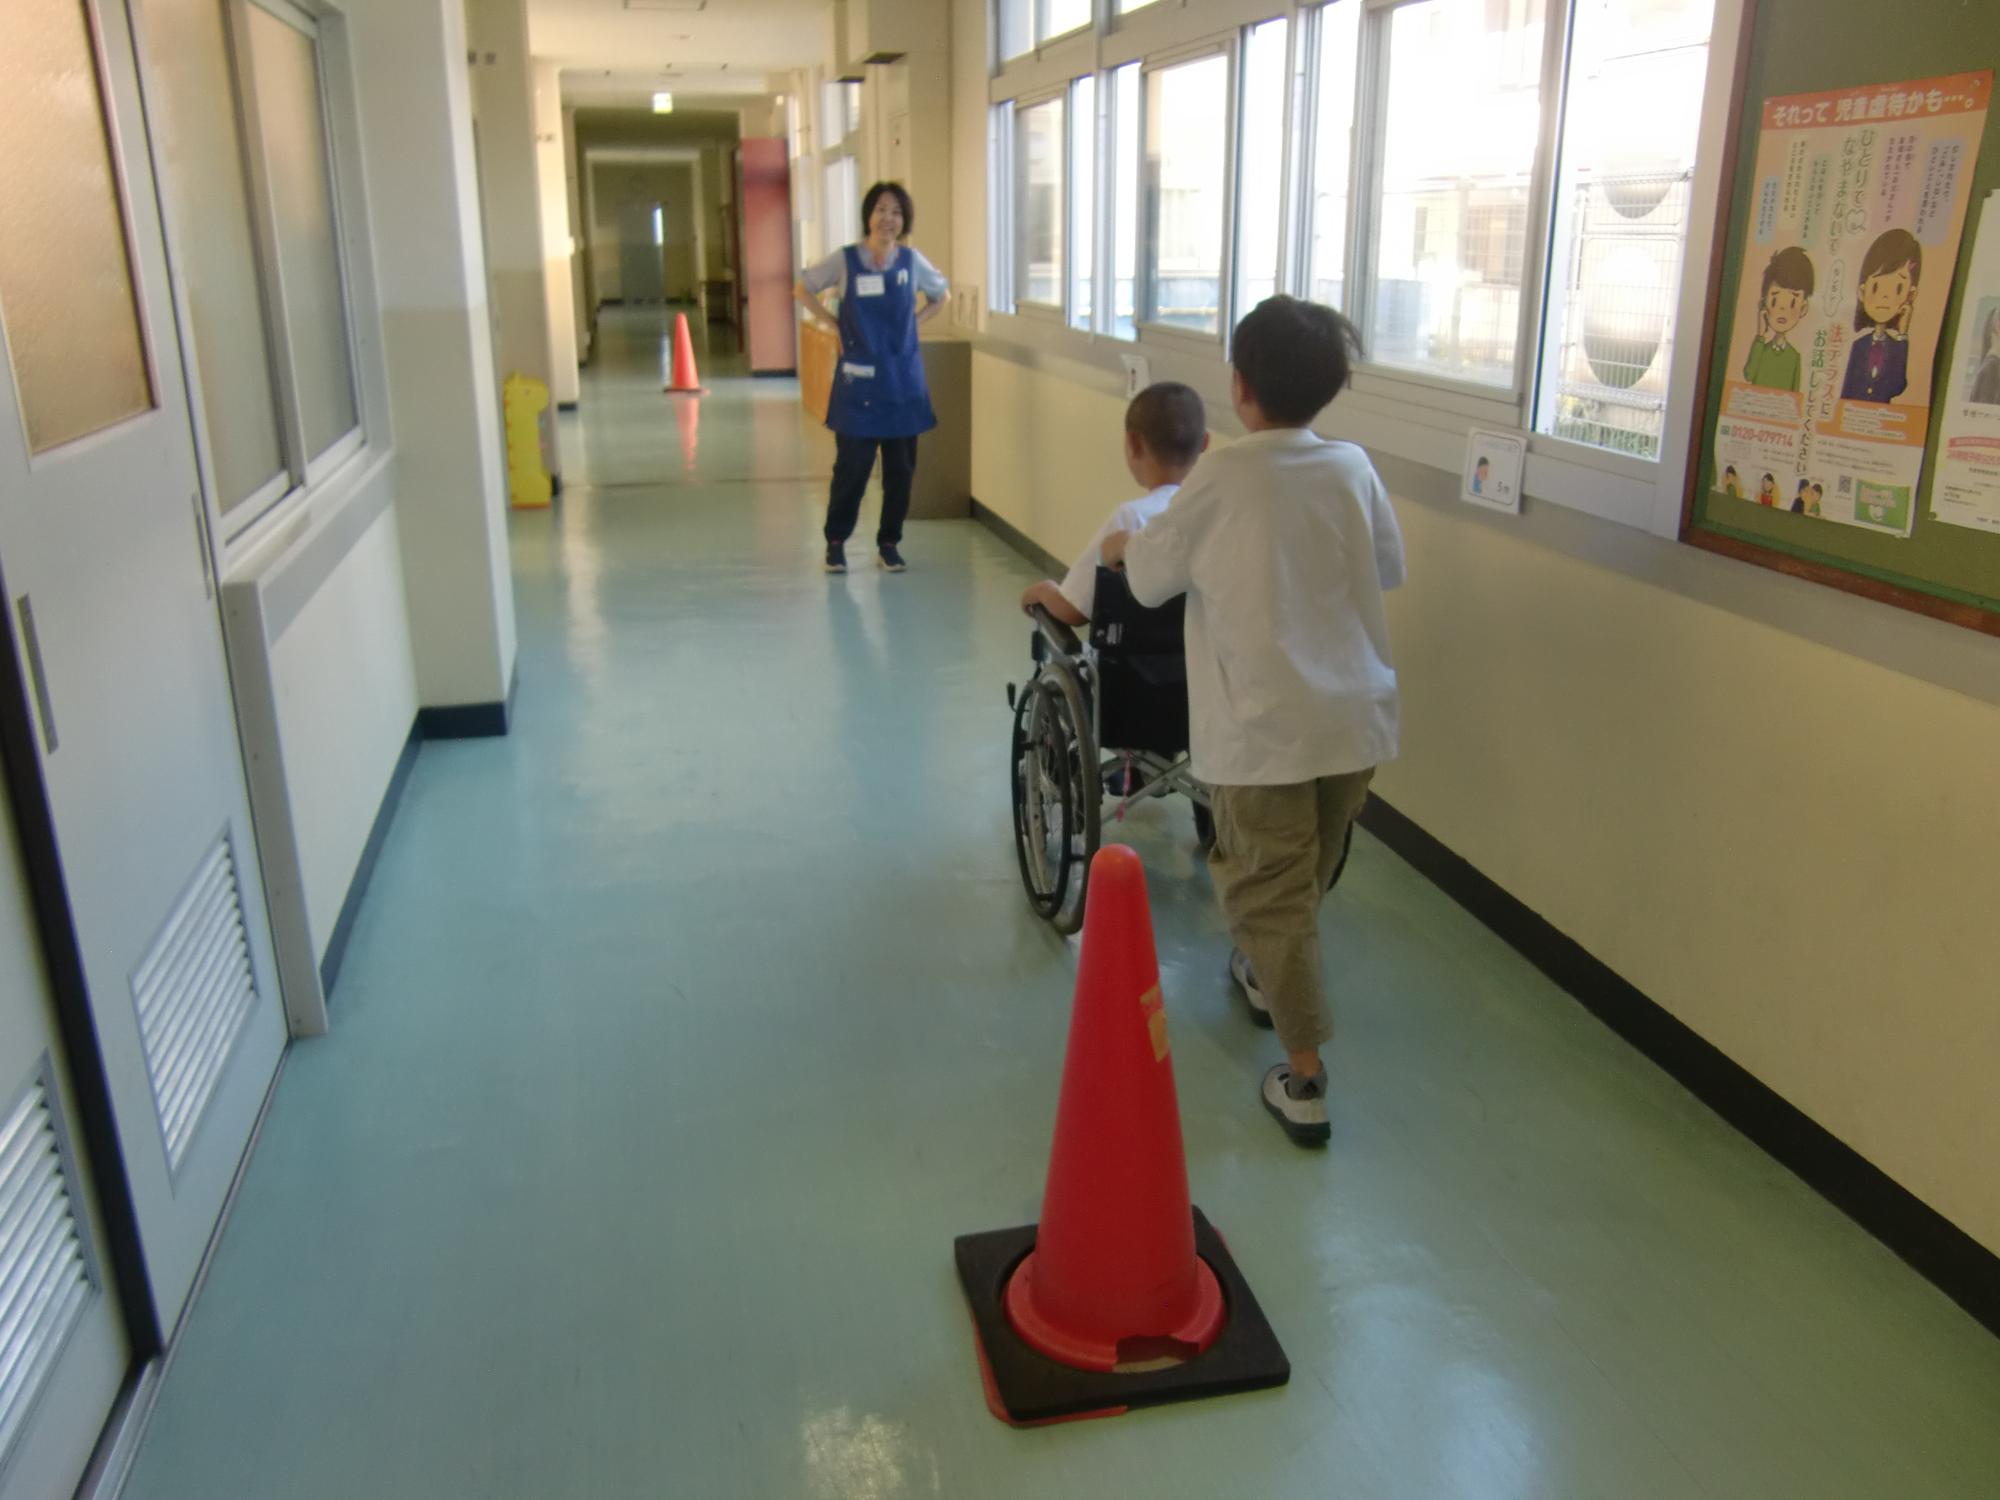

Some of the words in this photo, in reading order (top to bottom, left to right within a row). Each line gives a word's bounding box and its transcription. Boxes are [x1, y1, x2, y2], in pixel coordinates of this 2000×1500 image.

[1774, 101, 1830, 127] それって
[1855, 128, 1875, 208] ひとりで
[1796, 329, 1828, 474] お話ししてください
[1819, 323, 1844, 417] 法テラスに
